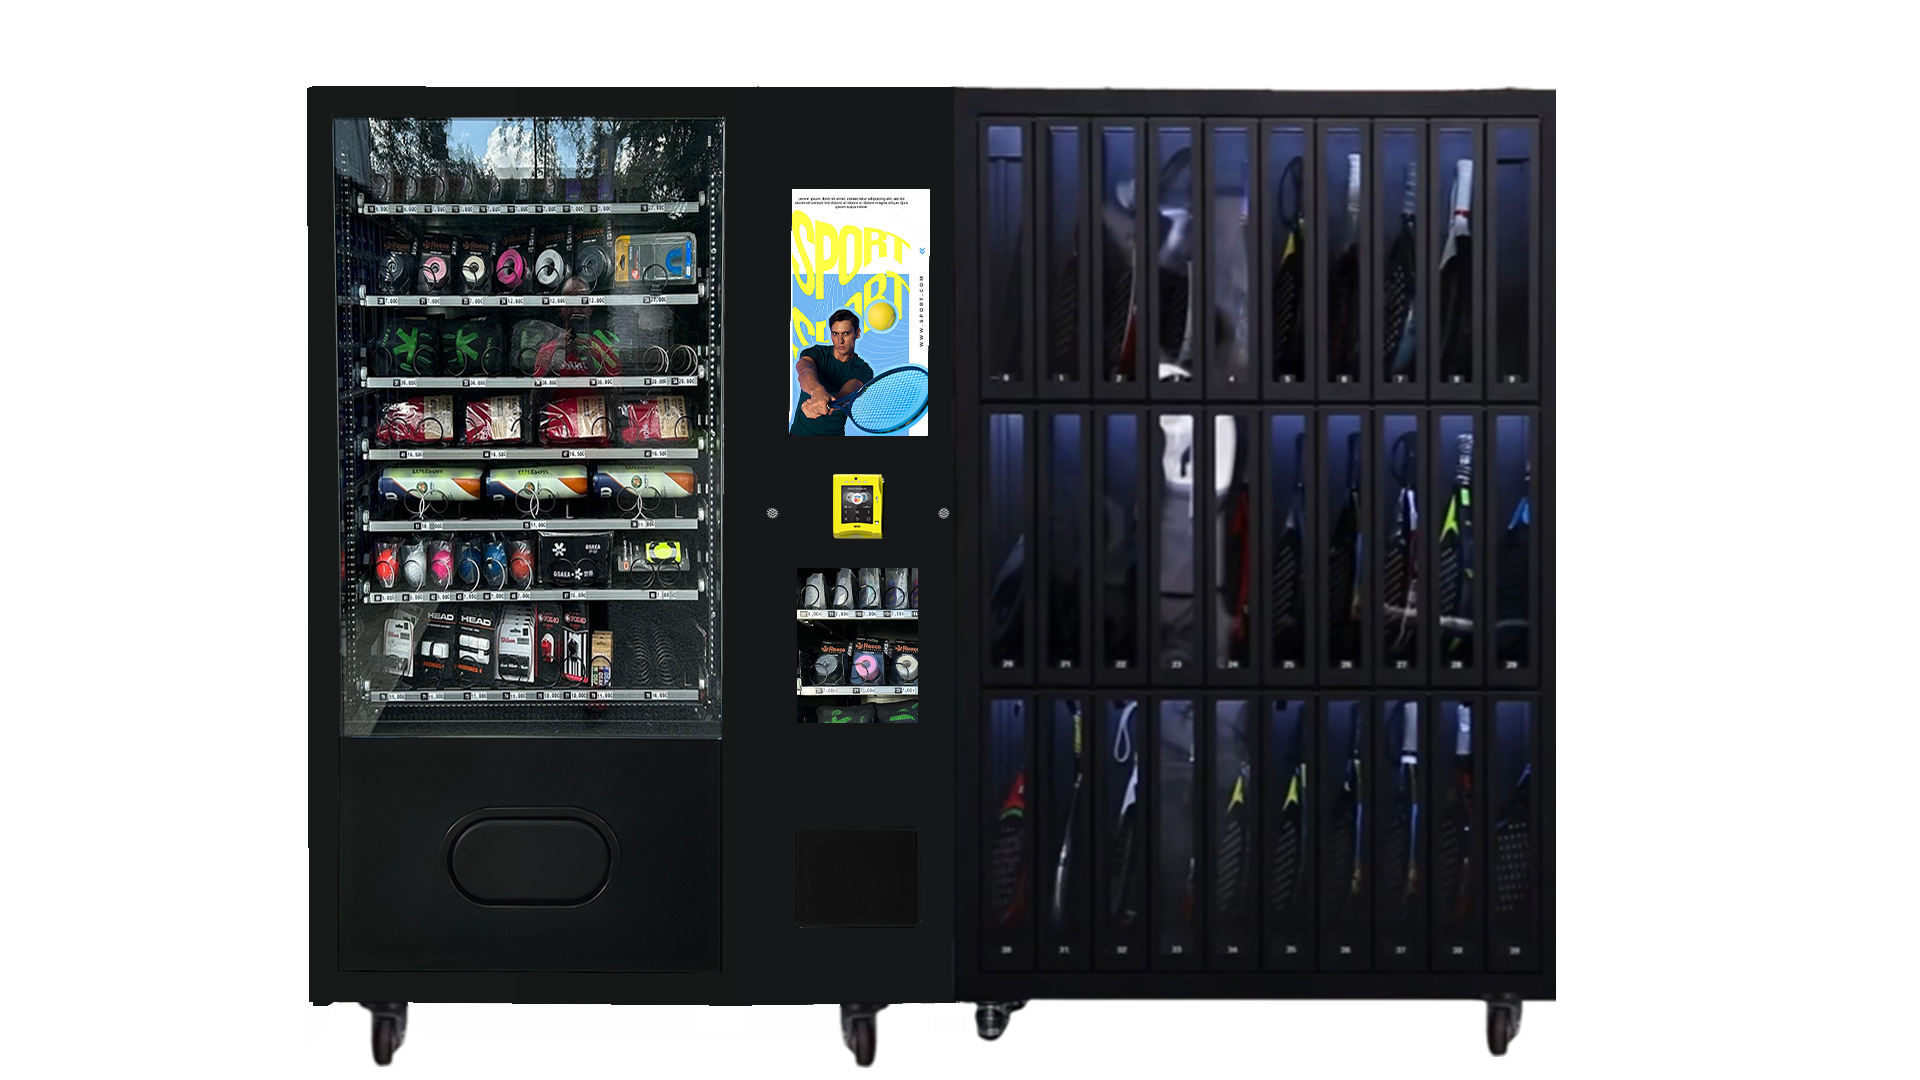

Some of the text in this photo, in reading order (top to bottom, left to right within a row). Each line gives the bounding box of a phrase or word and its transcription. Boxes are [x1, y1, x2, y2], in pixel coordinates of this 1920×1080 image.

[792, 210, 911, 300] SPORT
[553, 570, 571, 578] OSAKA
[427, 611, 455, 621] HEAD
[461, 615, 492, 627] HEAD
[864, 642, 882, 650] Reece
[1060, 659, 1072, 669] 21
[1115, 660, 1127, 669] 22
[1171, 660, 1183, 669] 23
[1227, 660, 1239, 669] 24
[1283, 660, 1295, 669] 25
[1340, 660, 1353, 669] 26
[1396, 660, 1408, 669] 27
[1450, 660, 1463, 669] 28
[1506, 660, 1518, 669] 29
[1059, 946, 1070, 954] 31
[1171, 945, 1183, 954] 33
[1286, 945, 1297, 954] 35
[1395, 946, 1407, 954] 37
